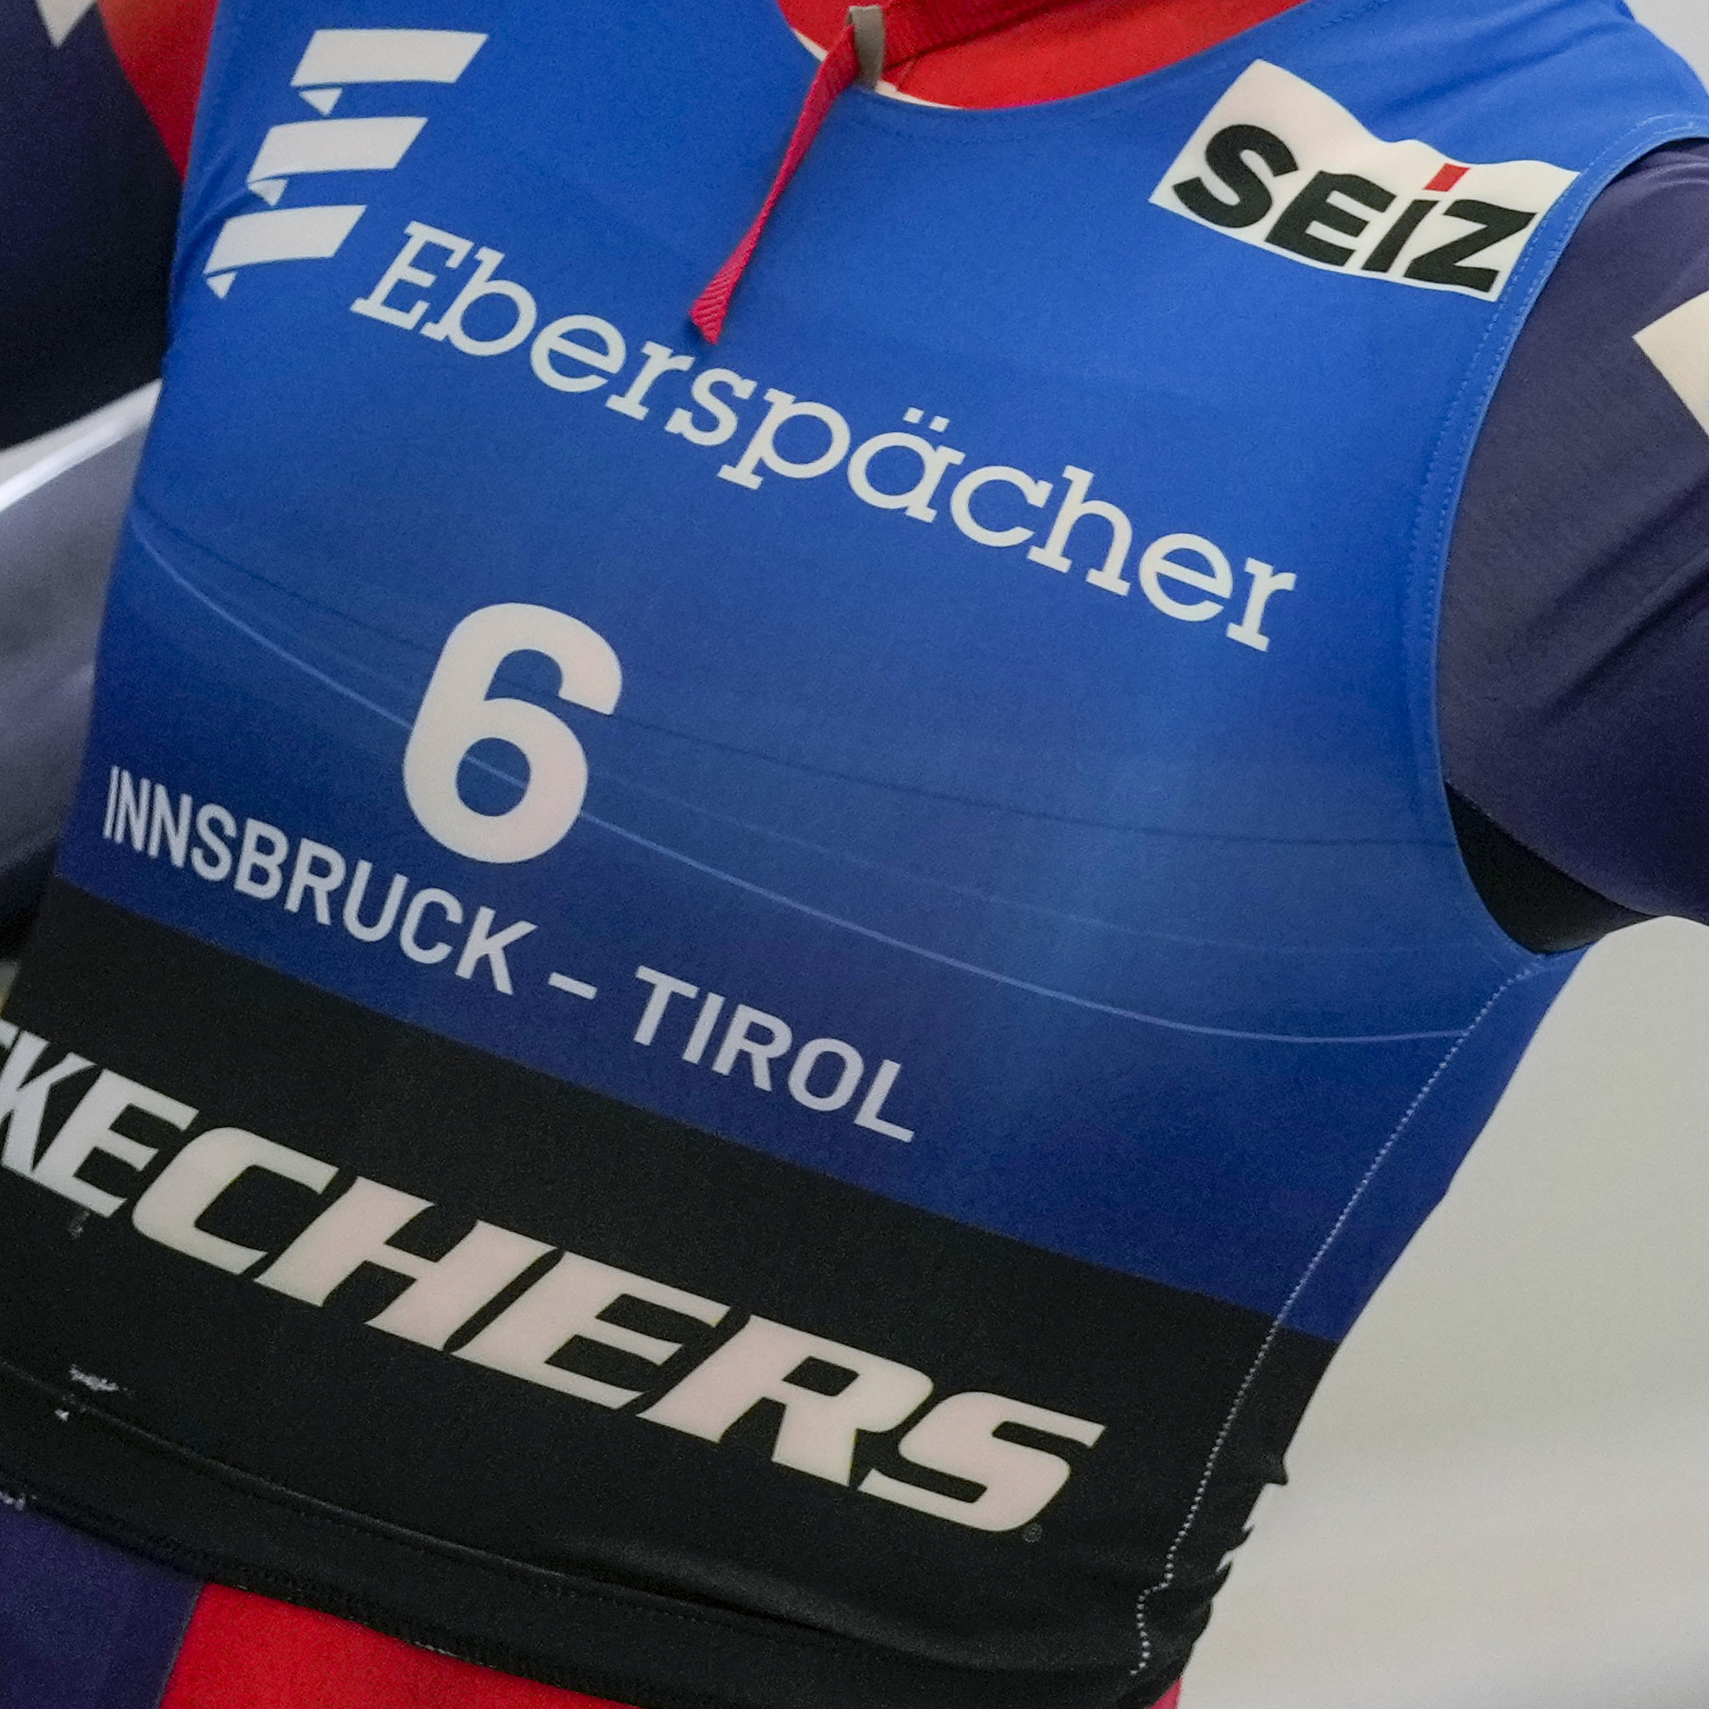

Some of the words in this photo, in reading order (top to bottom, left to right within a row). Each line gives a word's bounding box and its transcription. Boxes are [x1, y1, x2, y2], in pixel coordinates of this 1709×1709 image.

[349, 220, 1298, 653] Eberspächer
[402, 602, 623, 864] 6
[103, 765, 538, 997] INNSBRUCK
[632, 964, 916, 1144] TIROL
